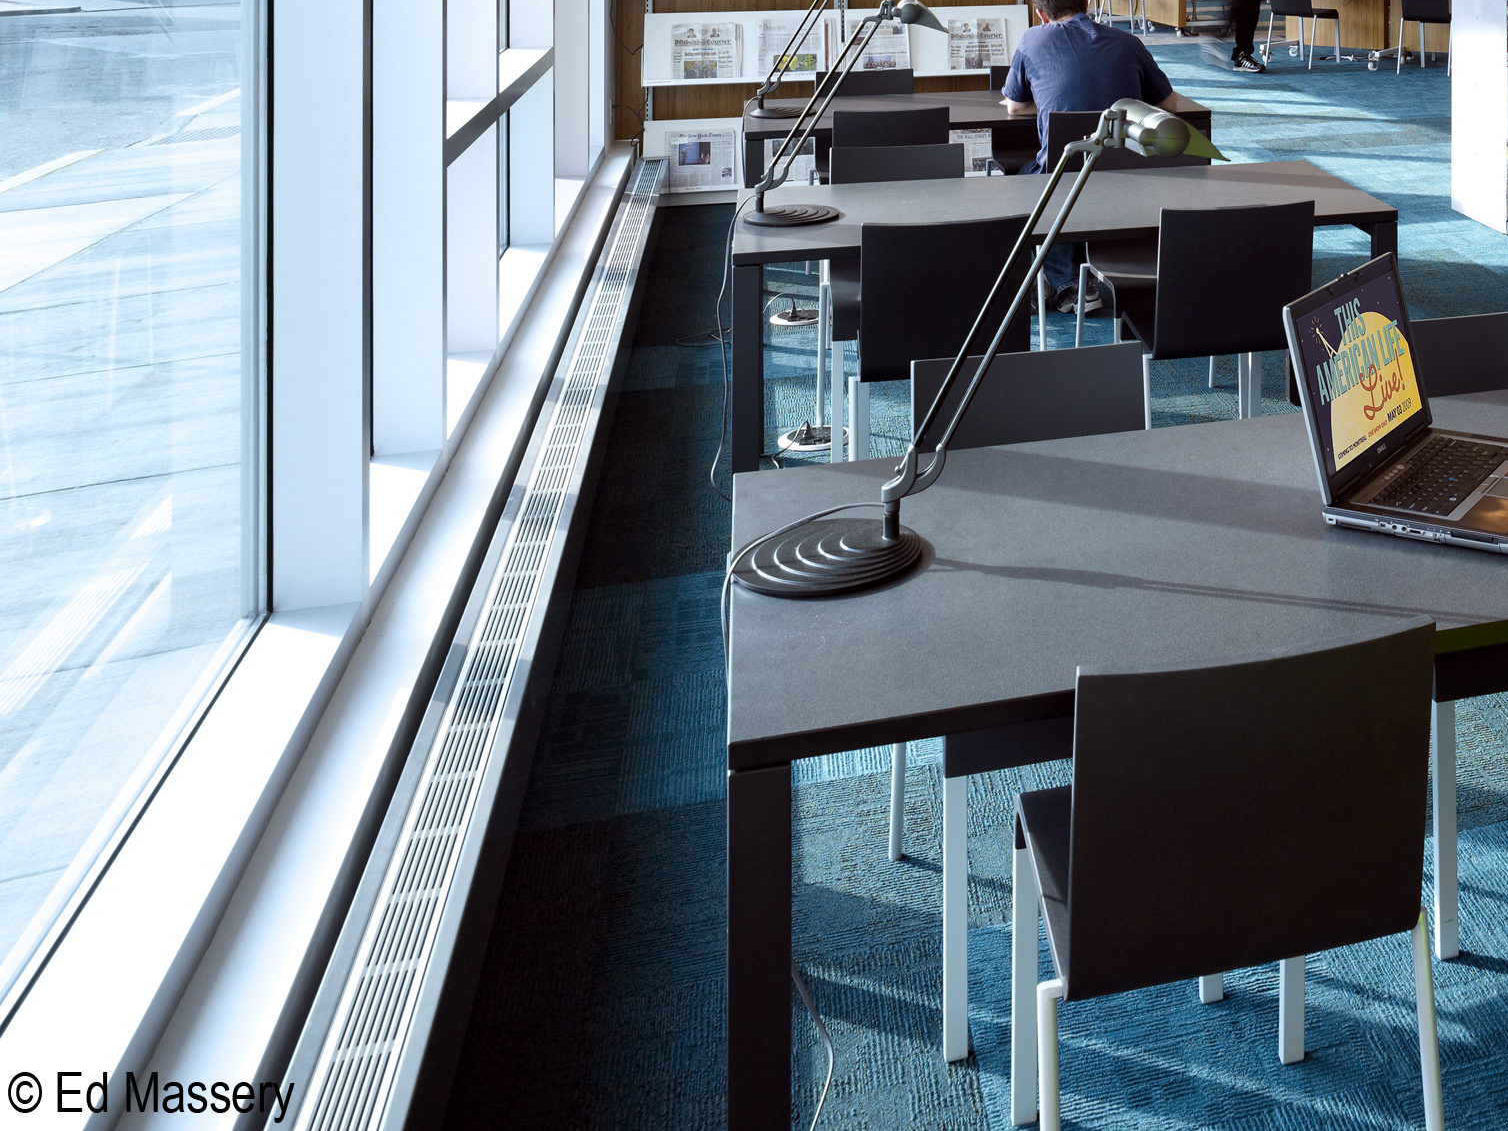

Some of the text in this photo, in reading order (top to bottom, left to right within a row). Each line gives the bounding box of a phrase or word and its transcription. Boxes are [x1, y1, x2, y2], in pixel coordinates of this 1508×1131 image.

[1334, 297, 1366, 346] THIS
[1316, 333, 1381, 406] AMERICAN
[1359, 348, 1406, 420] Live!
[1338, 448, 1350, 459] COMING
[1353, 435, 1367, 448] MONTREAL
[1387, 410, 1397, 423] MAY
[1402, 398, 1412, 412] 2009
[1377, 443, 1386, 454] DELL
